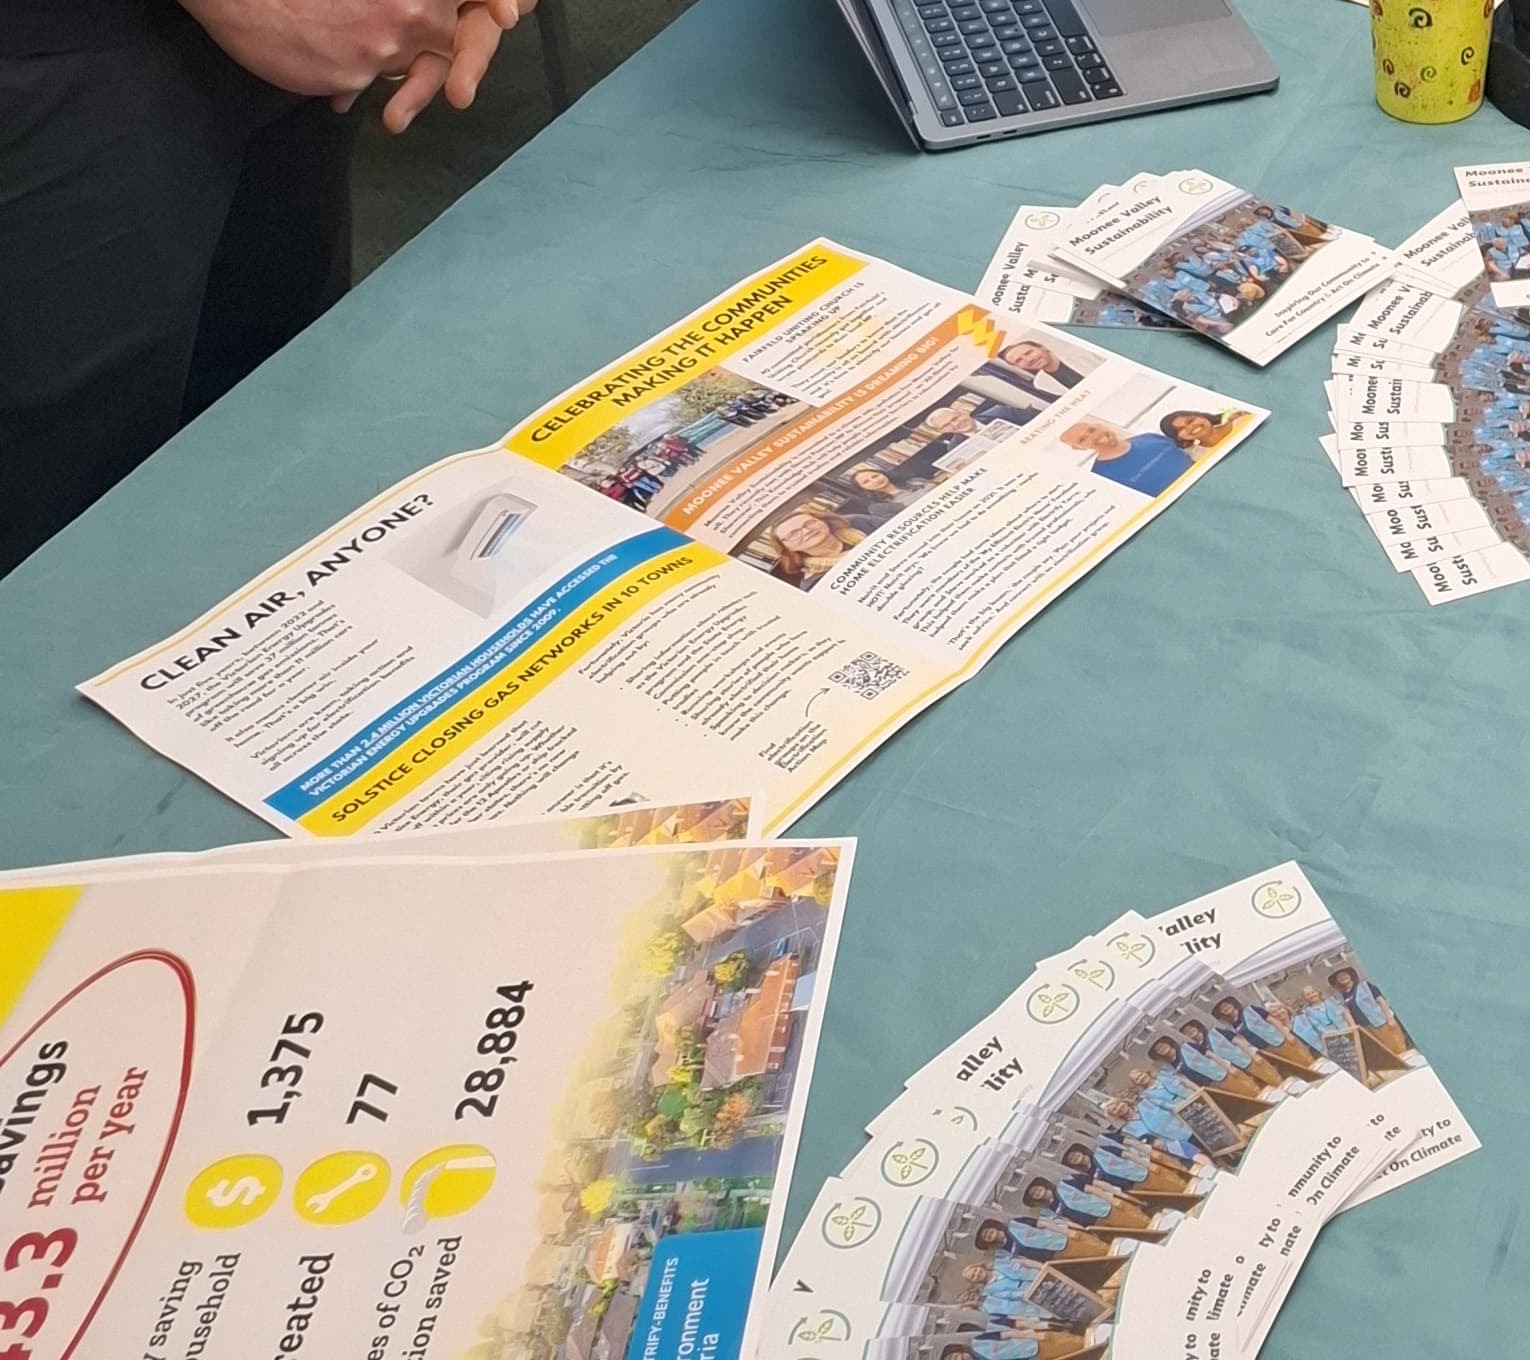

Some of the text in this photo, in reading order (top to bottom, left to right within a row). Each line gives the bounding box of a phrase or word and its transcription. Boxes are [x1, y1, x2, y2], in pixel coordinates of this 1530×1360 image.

[1465, 165, 1524, 178] Moonee
[1069, 193, 1163, 247] Moonee Valley
[1084, 205, 1173, 257] Sustainability
[1403, 231, 1449, 260] Moonee
[1007, 240, 1029, 273] Valley
[782, 311, 820, 336] UNITING
[819, 287, 855, 312] CHURCH
[1265, 324, 1284, 337] Care
[1282, 315, 1296, 326] For
[1295, 296, 1326, 317] Country
[1330, 284, 1344, 294] Act
[1342, 278, 1354, 286] On
[1352, 262, 1380, 280] Climate
[1274, 294, 1310, 318] Inspiring
[1306, 286, 1322, 296] Our
[1320, 262, 1363, 288] Community
[1368, 291, 1404, 329] Moonee
[531, 256, 828, 442] CELEBRATING THE COMMUNITIES
[611, 294, 793, 407] MAKING IT HAPPEN
[785, 305, 840, 344] SPEAKING UP
[682, 336, 940, 515] MOONEE VALLEY SUSTAINABILITY IS DREAMING BIG!
[1019, 389, 1092, 445] BEATING THE HEAT
[830, 467, 988, 590] COMMUNITY RESOURCES HELP MAKE
[839, 487, 976, 596] HOME ELECTRIFICATION EASIER
[140, 494, 434, 690] CLEAN AIR, ANYONE?
[177, 686, 197, 700] just
[195, 676, 215, 688] five
[240, 629, 282, 657] between
[306, 599, 325, 612] and
[300, 554, 618, 792] MORE THAN 2.4 MILLION VICTORIAN HOUSEHOLDS HAVE ACCESSED THE
[308, 608, 562, 796] VICTORIAN ENERGY UPGRADES PROGRAM SINCE 2009.
[332, 556, 694, 822] SOLSTICE CLOSING GAS NETWORKS IN 10 TOWNS
[1159, 907, 1217, 937] alley
[246, 1011, 325, 1127] 1,375
[454, 979, 535, 1122] 28,884
[0, 1040, 68, 1195] avings
[345, 1073, 399, 1125] 77
[1370, 1112, 1385, 1128] to
[1436, 1118, 1452, 1131] to
[27, 1085, 101, 1209] million
[71, 1067, 149, 1206] per year
[1327, 1135, 1342, 1151] to
[1390, 1133, 1462, 1172] On Climate
[1321, 1144, 1360, 1194] Climate
[1266, 1217, 1281, 1233] to
[424, 1235, 464, 1311] saved
[1200, 1268, 1212, 1286] to
[149, 1260, 204, 1347] saving
[374, 1304, 402, 1338] of
